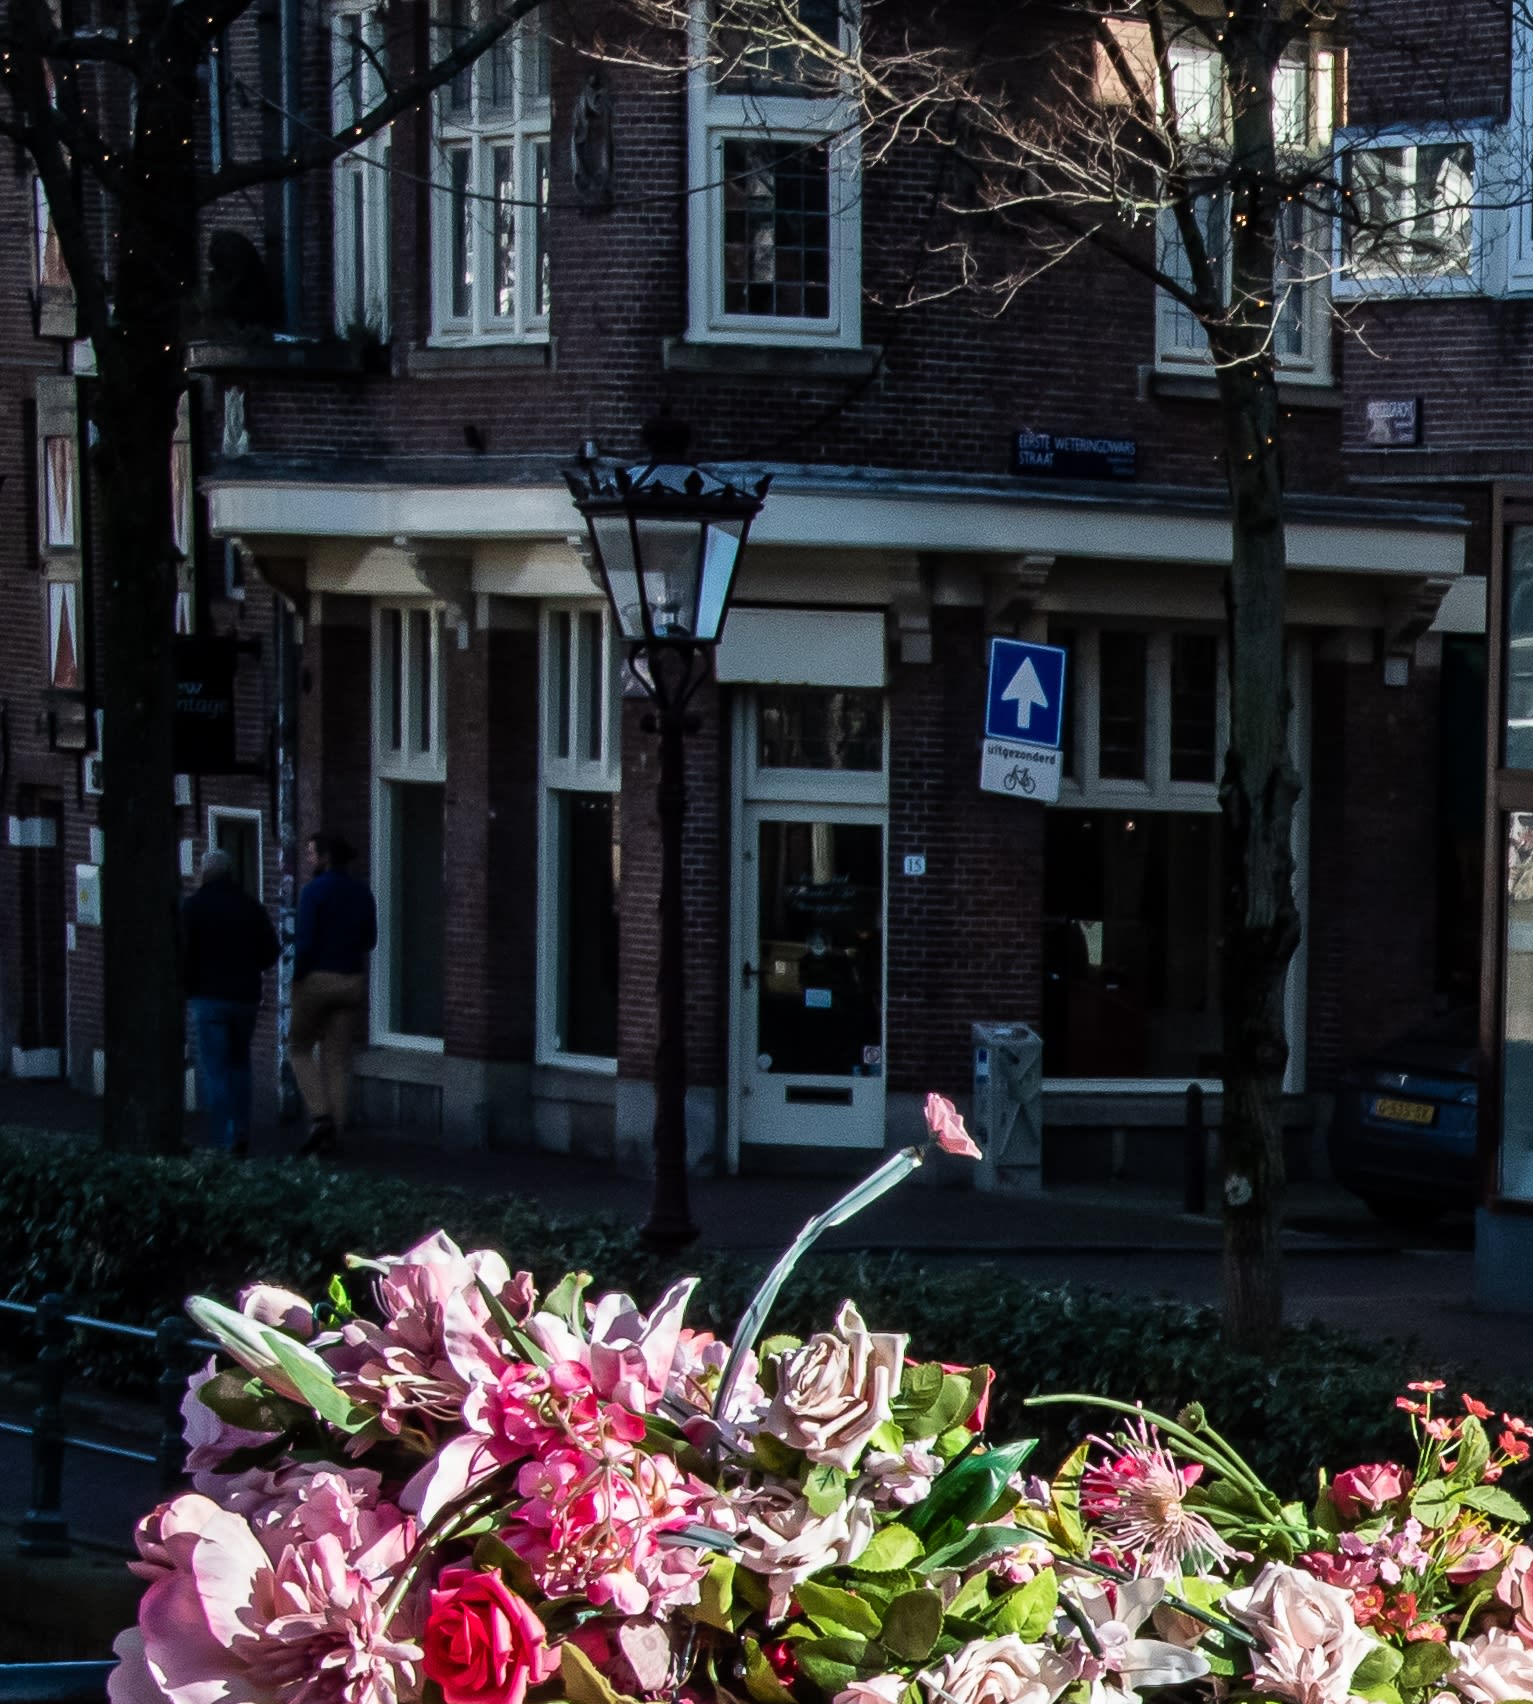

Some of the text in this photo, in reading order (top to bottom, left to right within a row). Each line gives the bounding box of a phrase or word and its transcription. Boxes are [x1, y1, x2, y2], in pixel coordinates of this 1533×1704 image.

[1018, 433, 1051, 450] EERSTE
[1018, 450, 1055, 466] STRAAT
[987, 746, 1057, 765] uitgezonderd
[908, 858, 923, 873] 15
